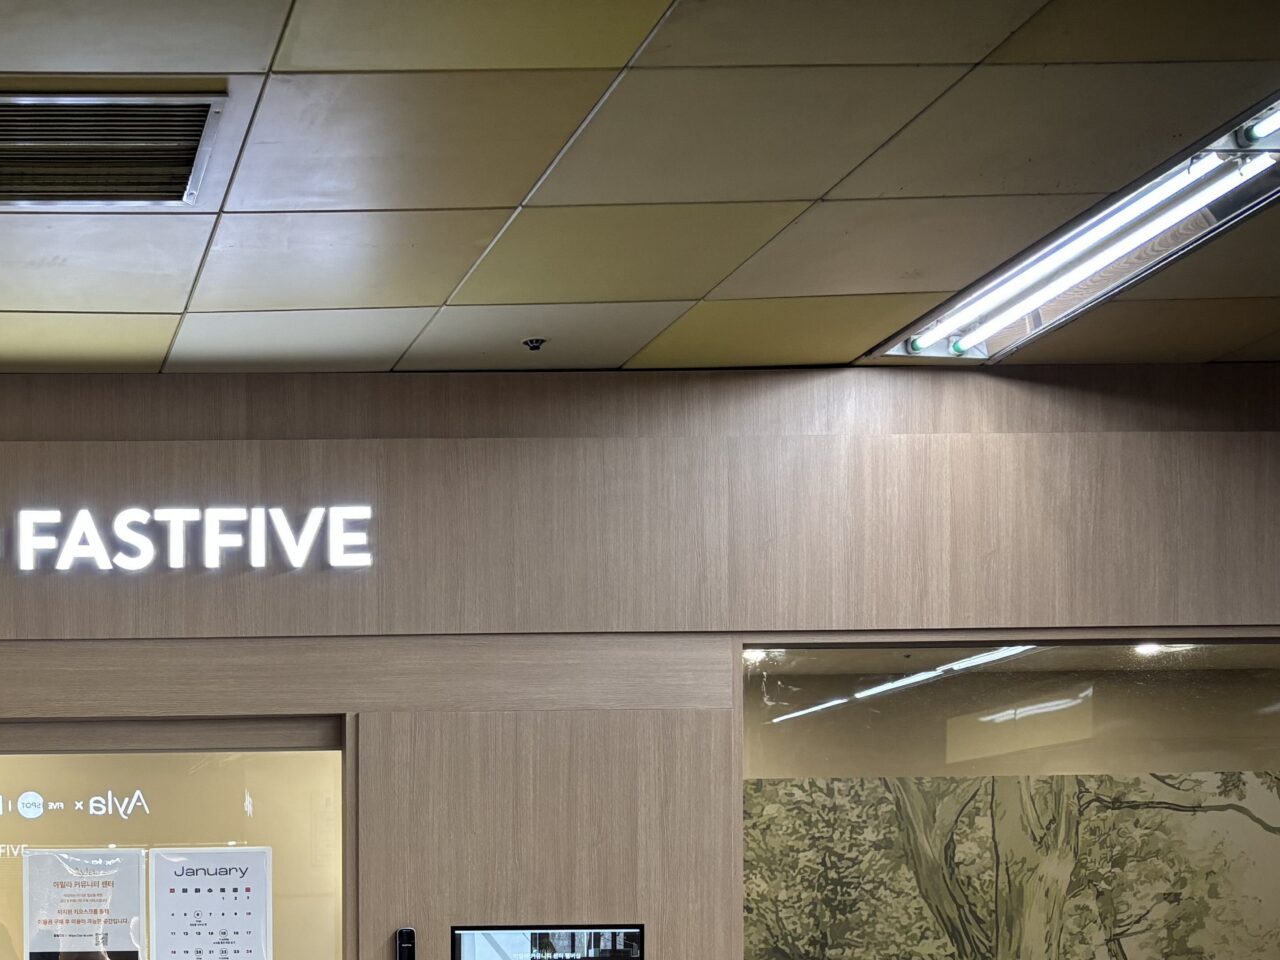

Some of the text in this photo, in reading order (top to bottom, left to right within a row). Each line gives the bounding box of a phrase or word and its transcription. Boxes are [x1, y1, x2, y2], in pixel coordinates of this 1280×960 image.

[18, 505, 373, 571] FASTFIVE
[174, 866, 248, 878] January
[74, 880, 99, 888] 커뮤니티
